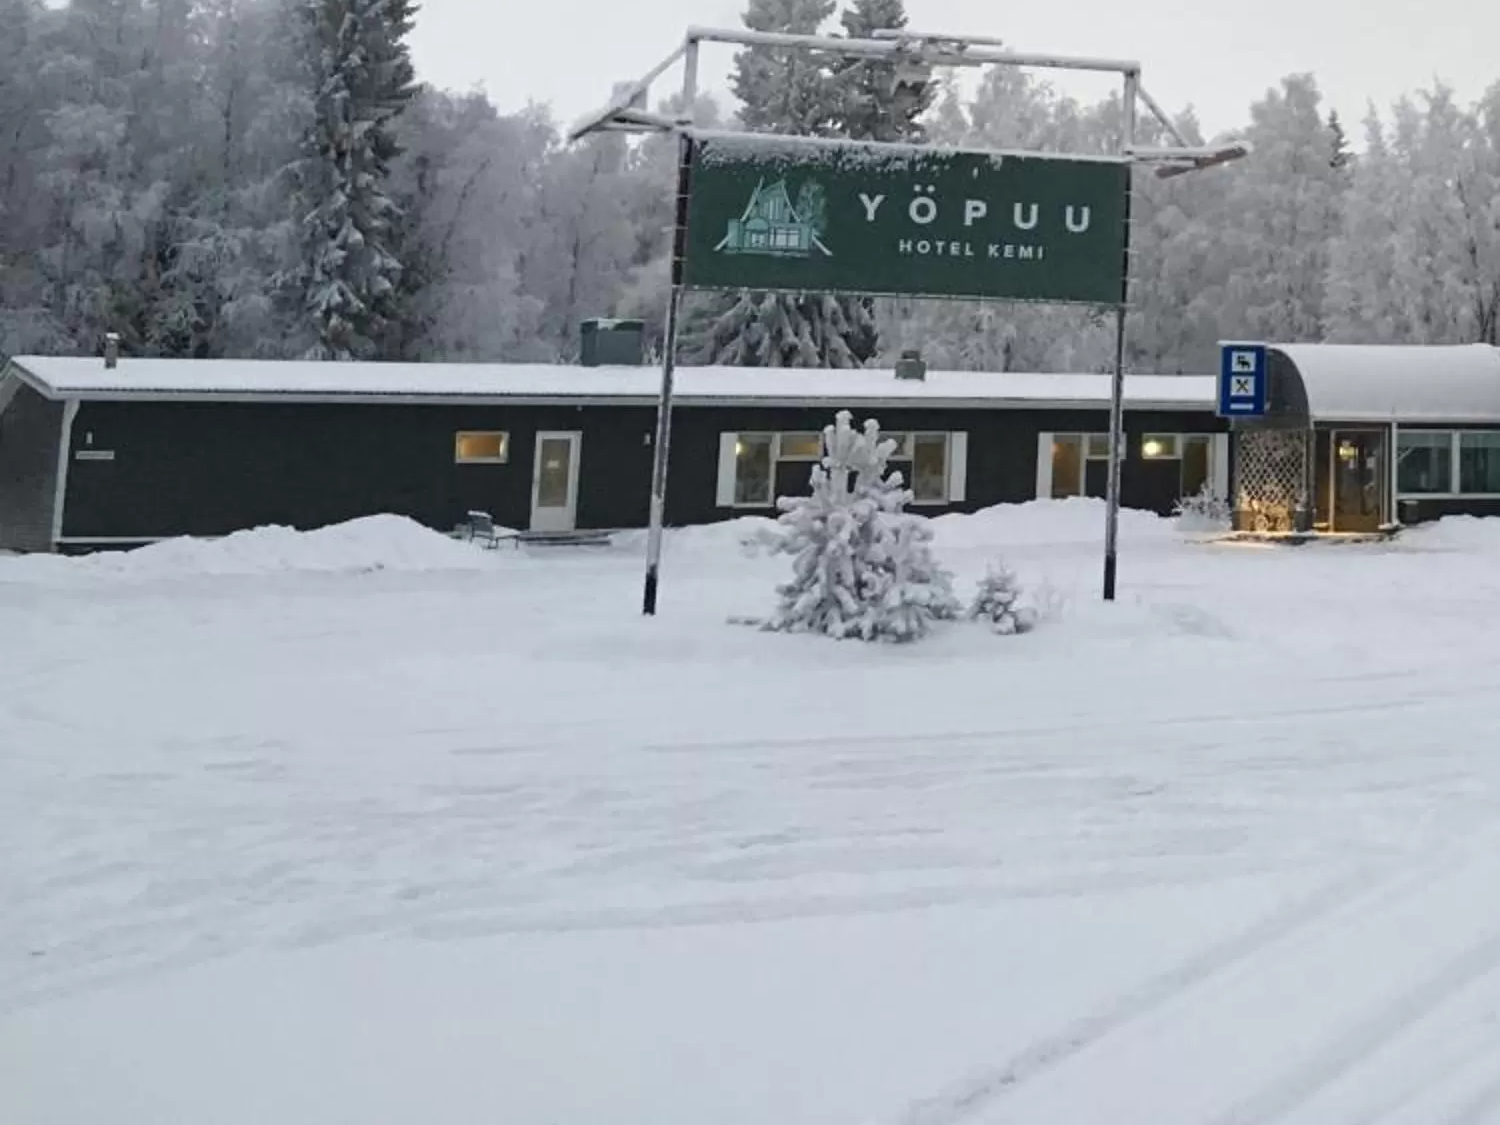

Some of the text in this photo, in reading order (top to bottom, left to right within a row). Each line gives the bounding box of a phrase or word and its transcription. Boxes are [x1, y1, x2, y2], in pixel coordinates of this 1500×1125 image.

[858, 184, 1091, 233] YÖPUU
[899, 238, 1045, 260] HOTEL KEMI
